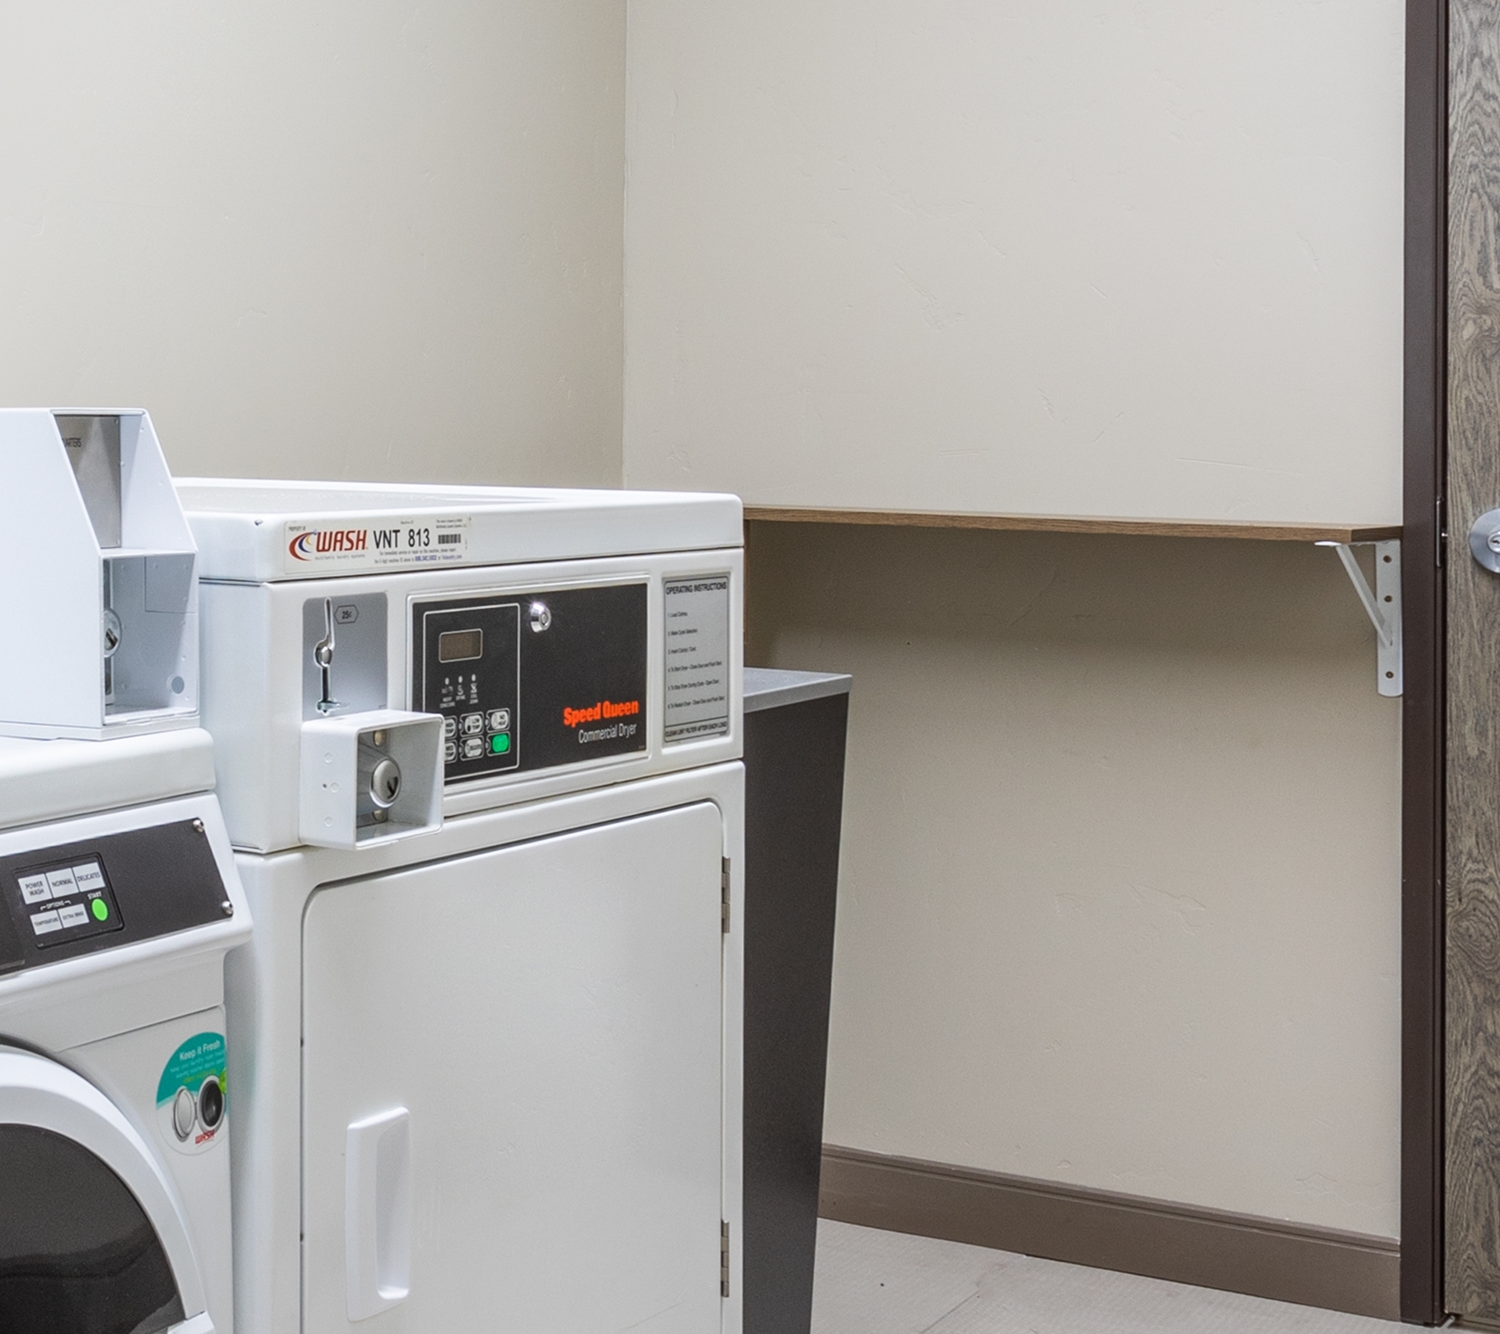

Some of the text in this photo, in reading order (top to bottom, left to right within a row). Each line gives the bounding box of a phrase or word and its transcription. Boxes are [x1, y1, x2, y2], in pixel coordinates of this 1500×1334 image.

[316, 528, 430, 553] WASH VNT 813
[563, 700, 639, 728] Speed Queen
[578, 723, 637, 744] Commercial Dryer
[51, 878, 73, 887] NORMAL
[77, 872, 100, 882] DELICATES
[26, 881, 43, 889] POWER
